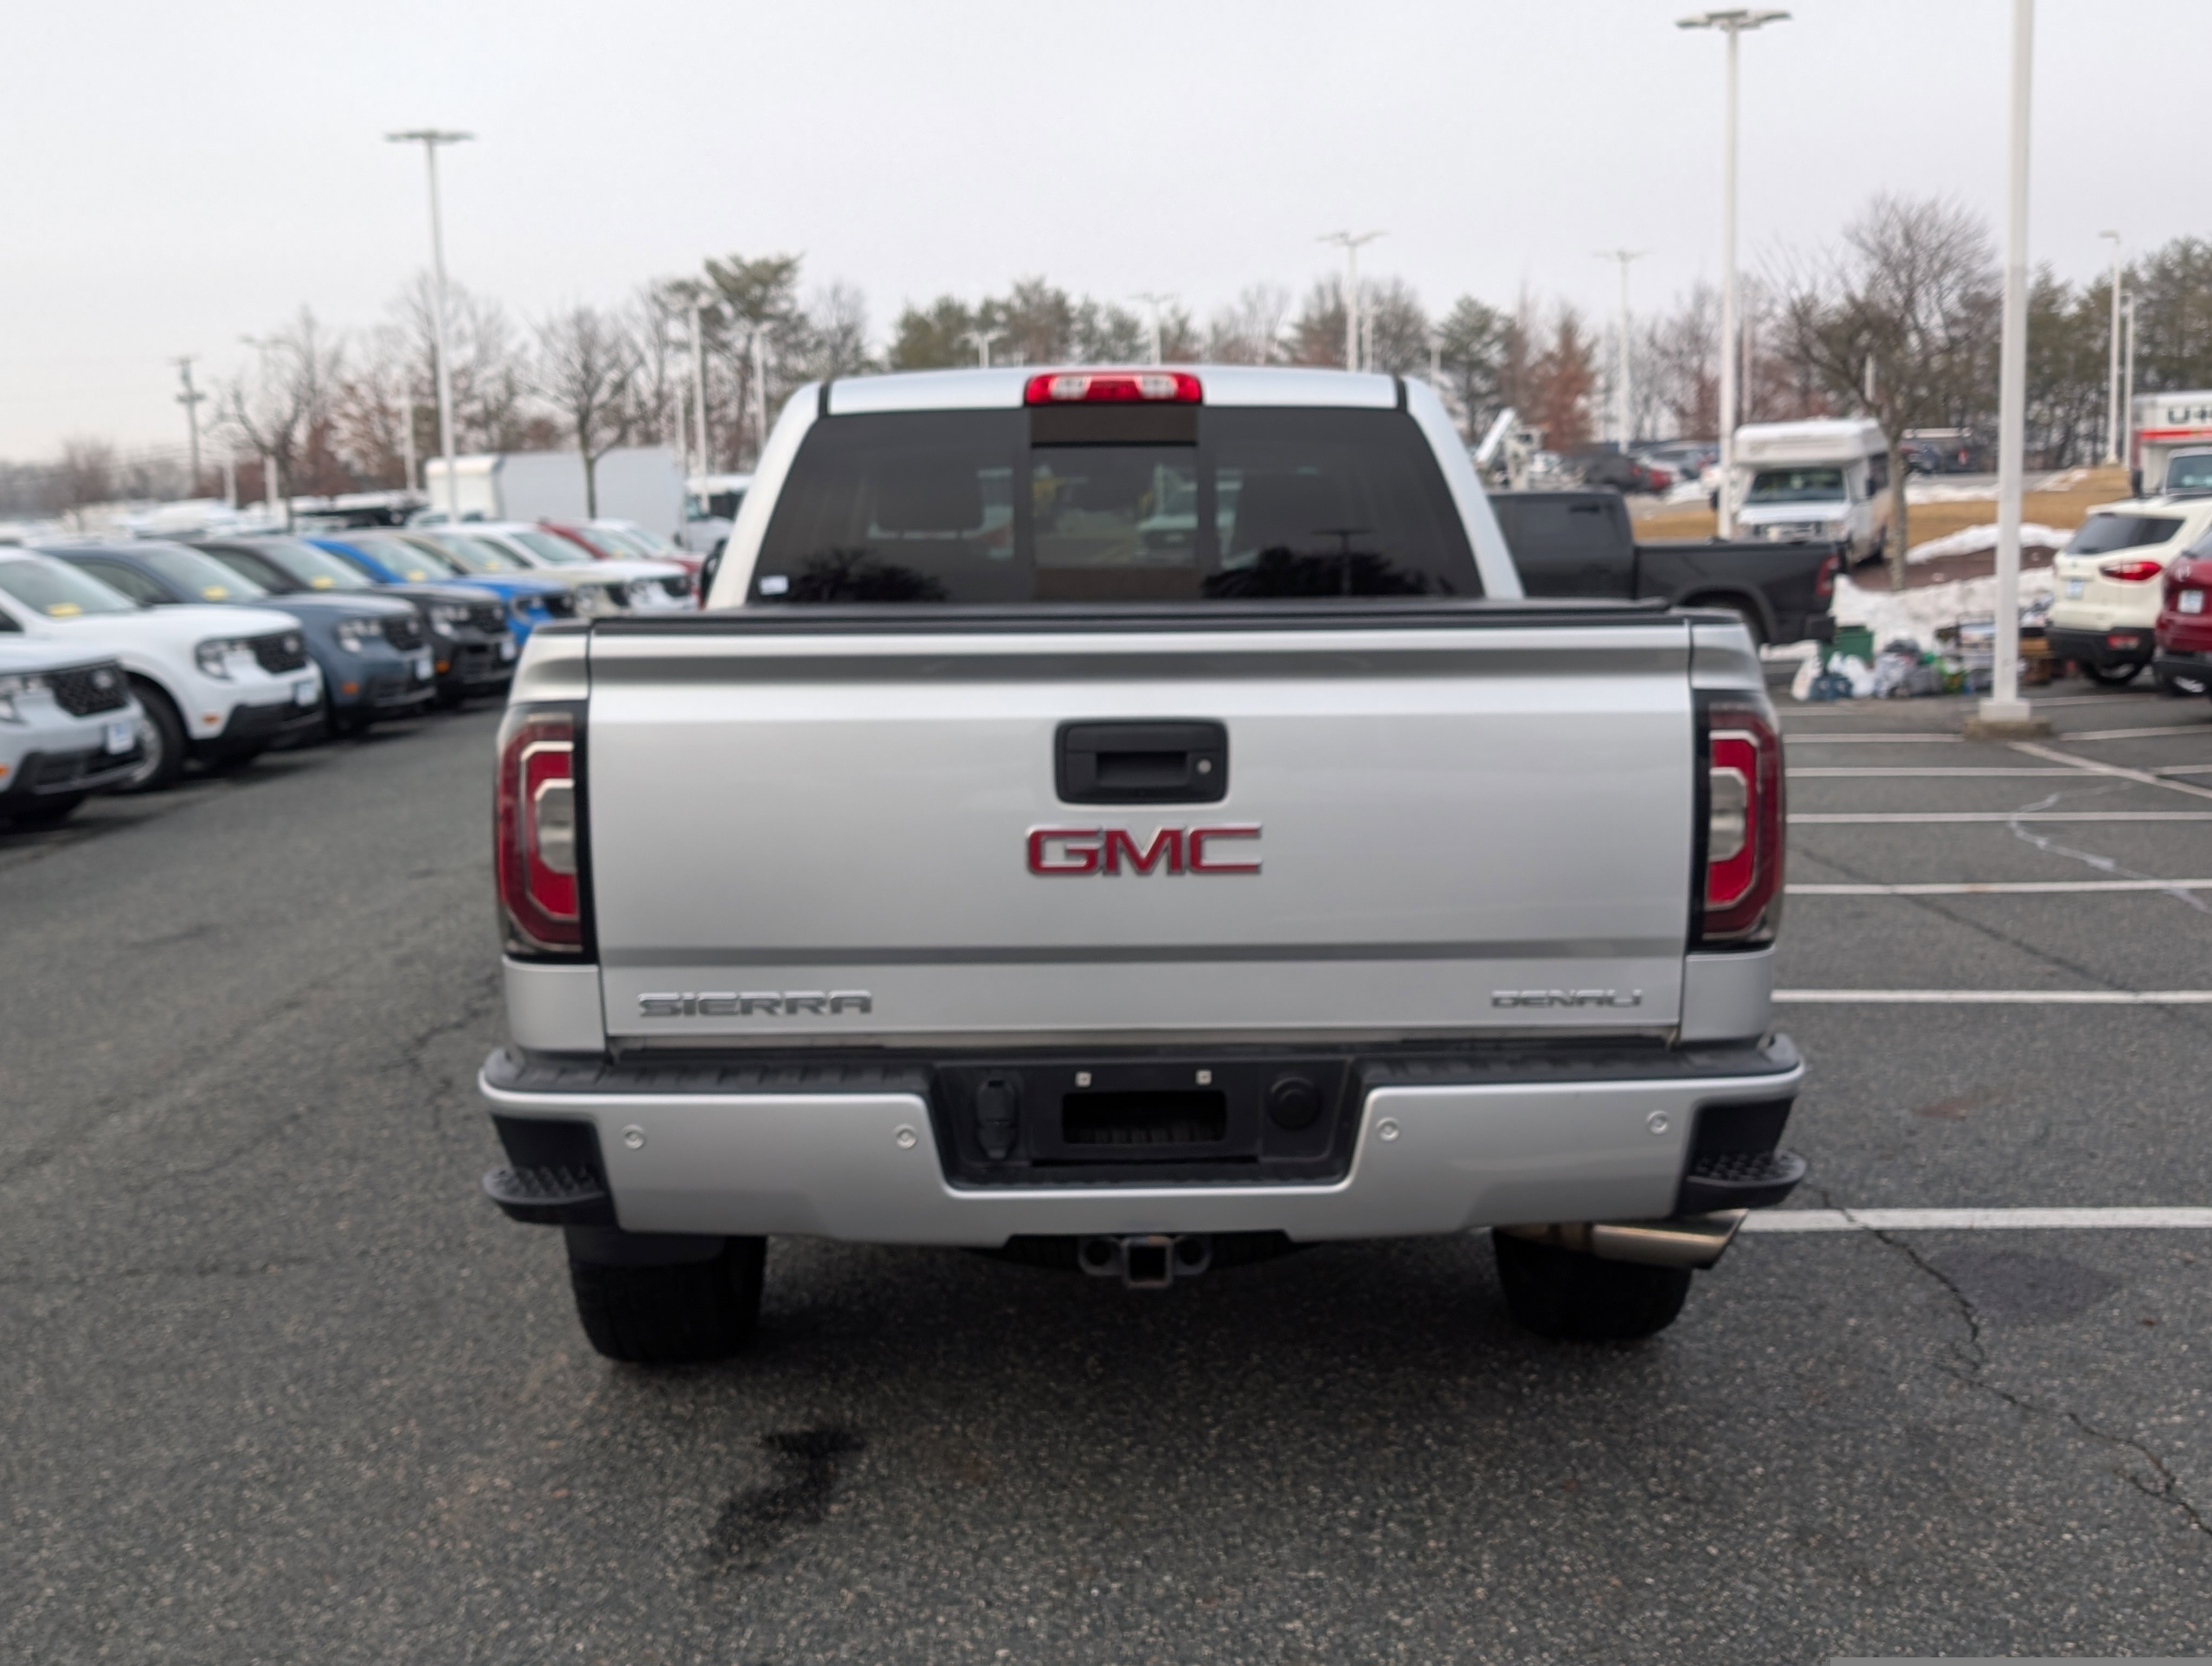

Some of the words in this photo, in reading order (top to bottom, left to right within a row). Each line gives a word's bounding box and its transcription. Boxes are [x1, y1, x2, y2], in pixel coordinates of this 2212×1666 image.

[1026, 823, 1262, 875] GMC
[638, 990, 872, 1016] SIERRA
[1491, 989, 1642, 1008] DENALI
